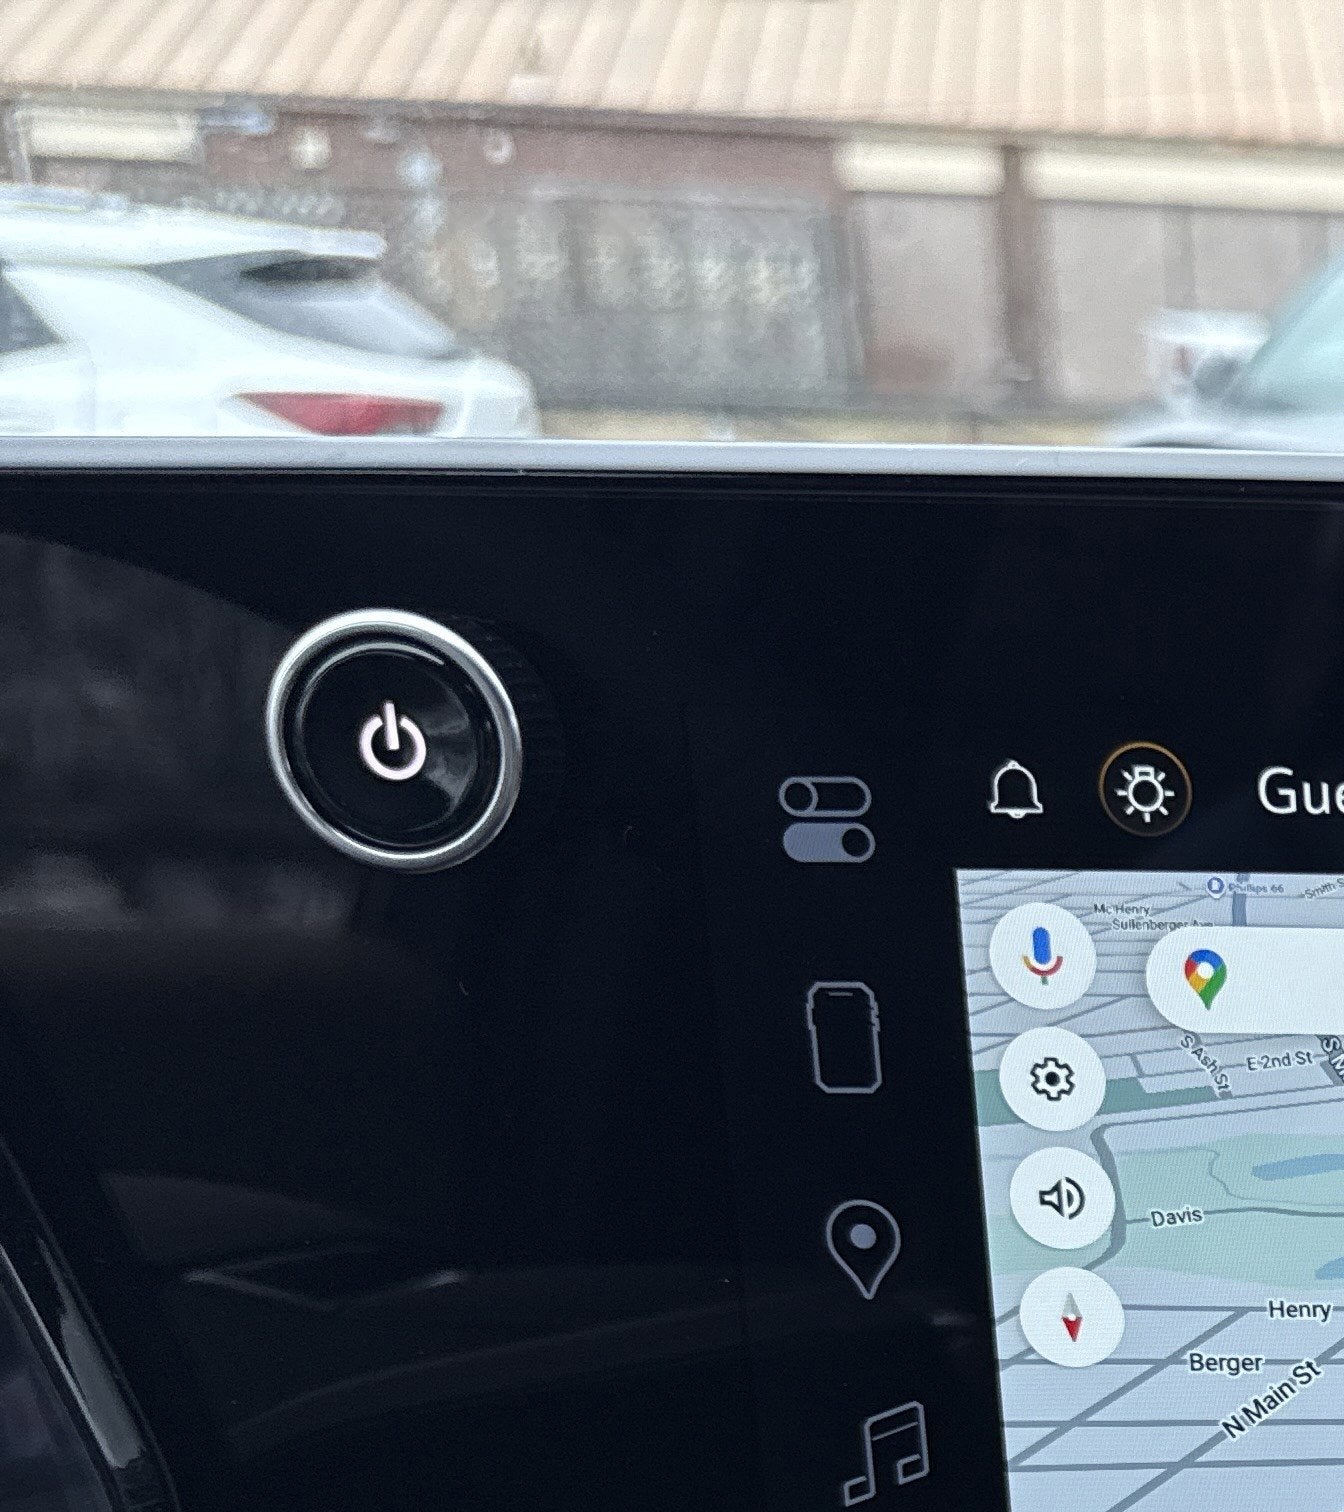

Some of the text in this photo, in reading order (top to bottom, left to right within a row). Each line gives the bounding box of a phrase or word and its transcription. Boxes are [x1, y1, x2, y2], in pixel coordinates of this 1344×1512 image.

[1303, 882, 1335, 900] Smith
[1321, 1034, 1342, 1052] S
[1180, 1035, 1230, 1092] S Ash St
[1247, 1050, 1313, 1071] E 2nd St
[1151, 1208, 1203, 1227] Davis
[1269, 1300, 1332, 1323] Henry
[1190, 1352, 1265, 1376] Berger
[1221, 1359, 1322, 1439] N Main St
